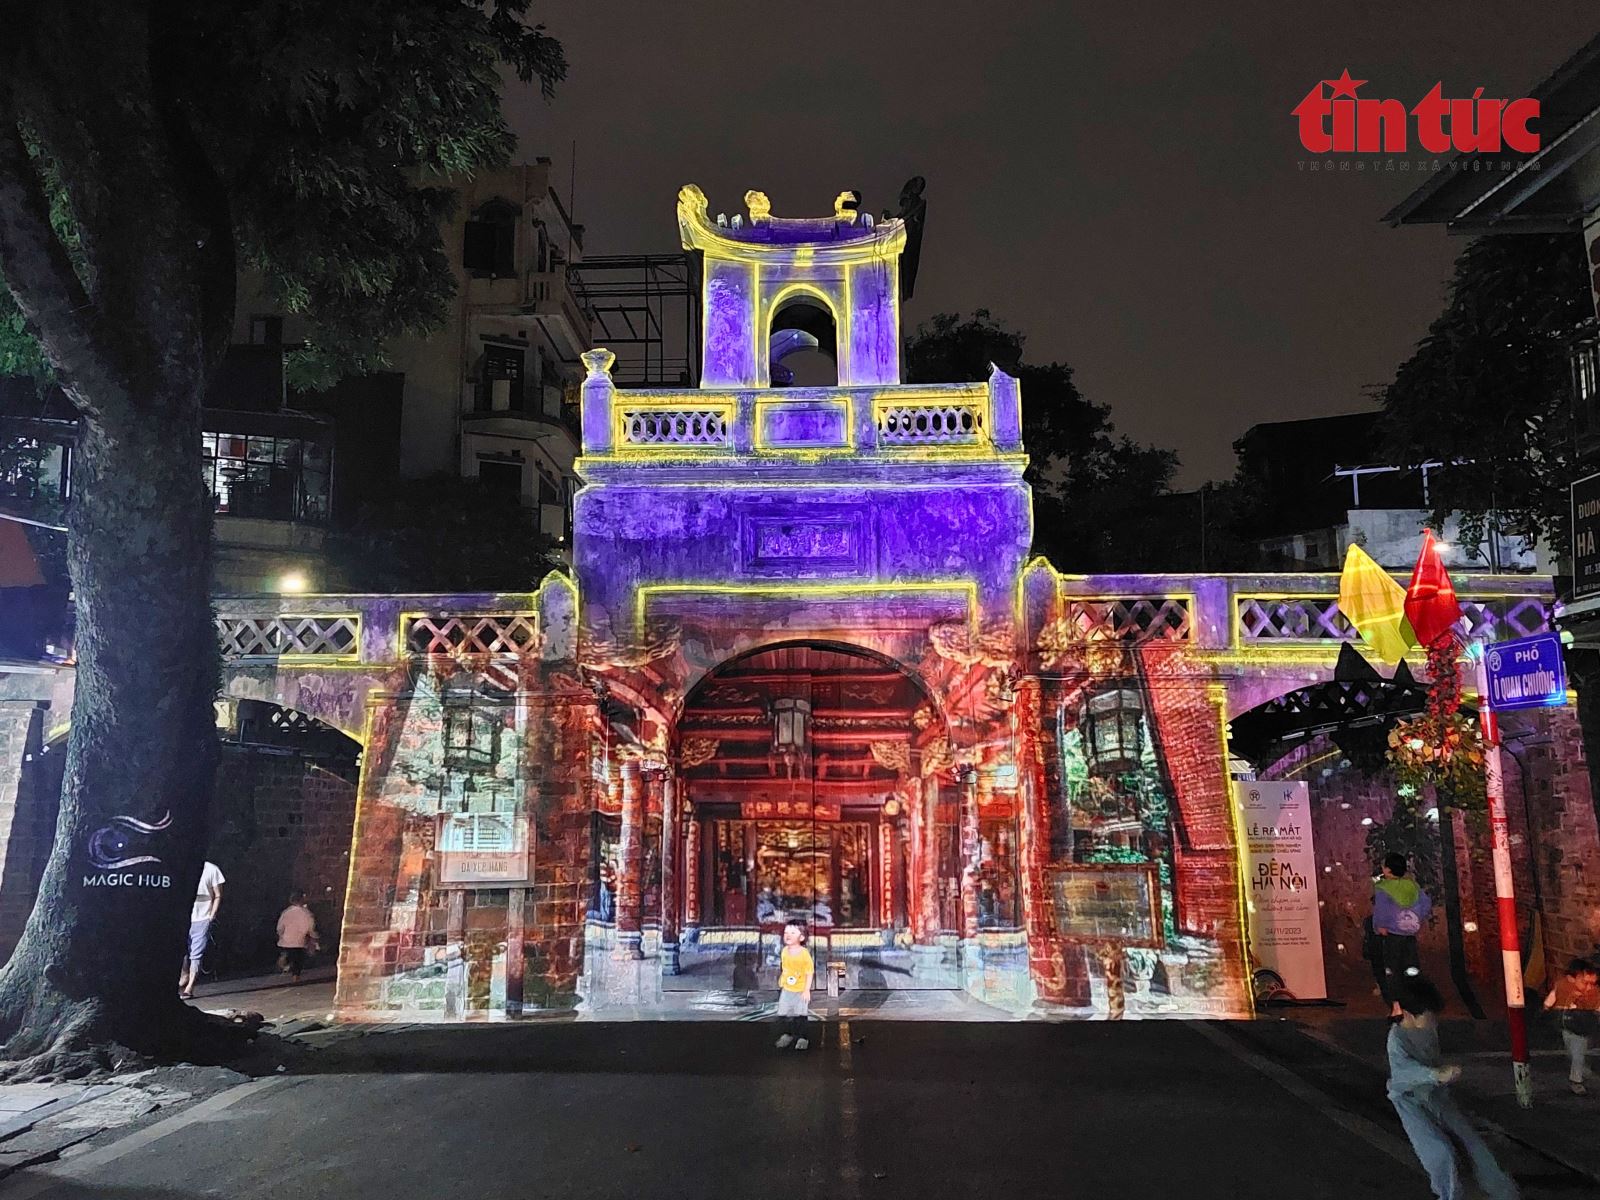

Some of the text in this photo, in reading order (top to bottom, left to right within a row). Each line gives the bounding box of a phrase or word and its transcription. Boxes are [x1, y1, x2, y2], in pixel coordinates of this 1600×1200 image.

[1515, 643, 1539, 663] PHỐ
[1494, 674, 1500, 700] Ô
[1501, 675, 1522, 701] QUAN
[1258, 857, 1293, 876] ĐÊM
[82, 873, 171, 888] MAGIC HUB
[1280, 872, 1307, 893] NỘI
